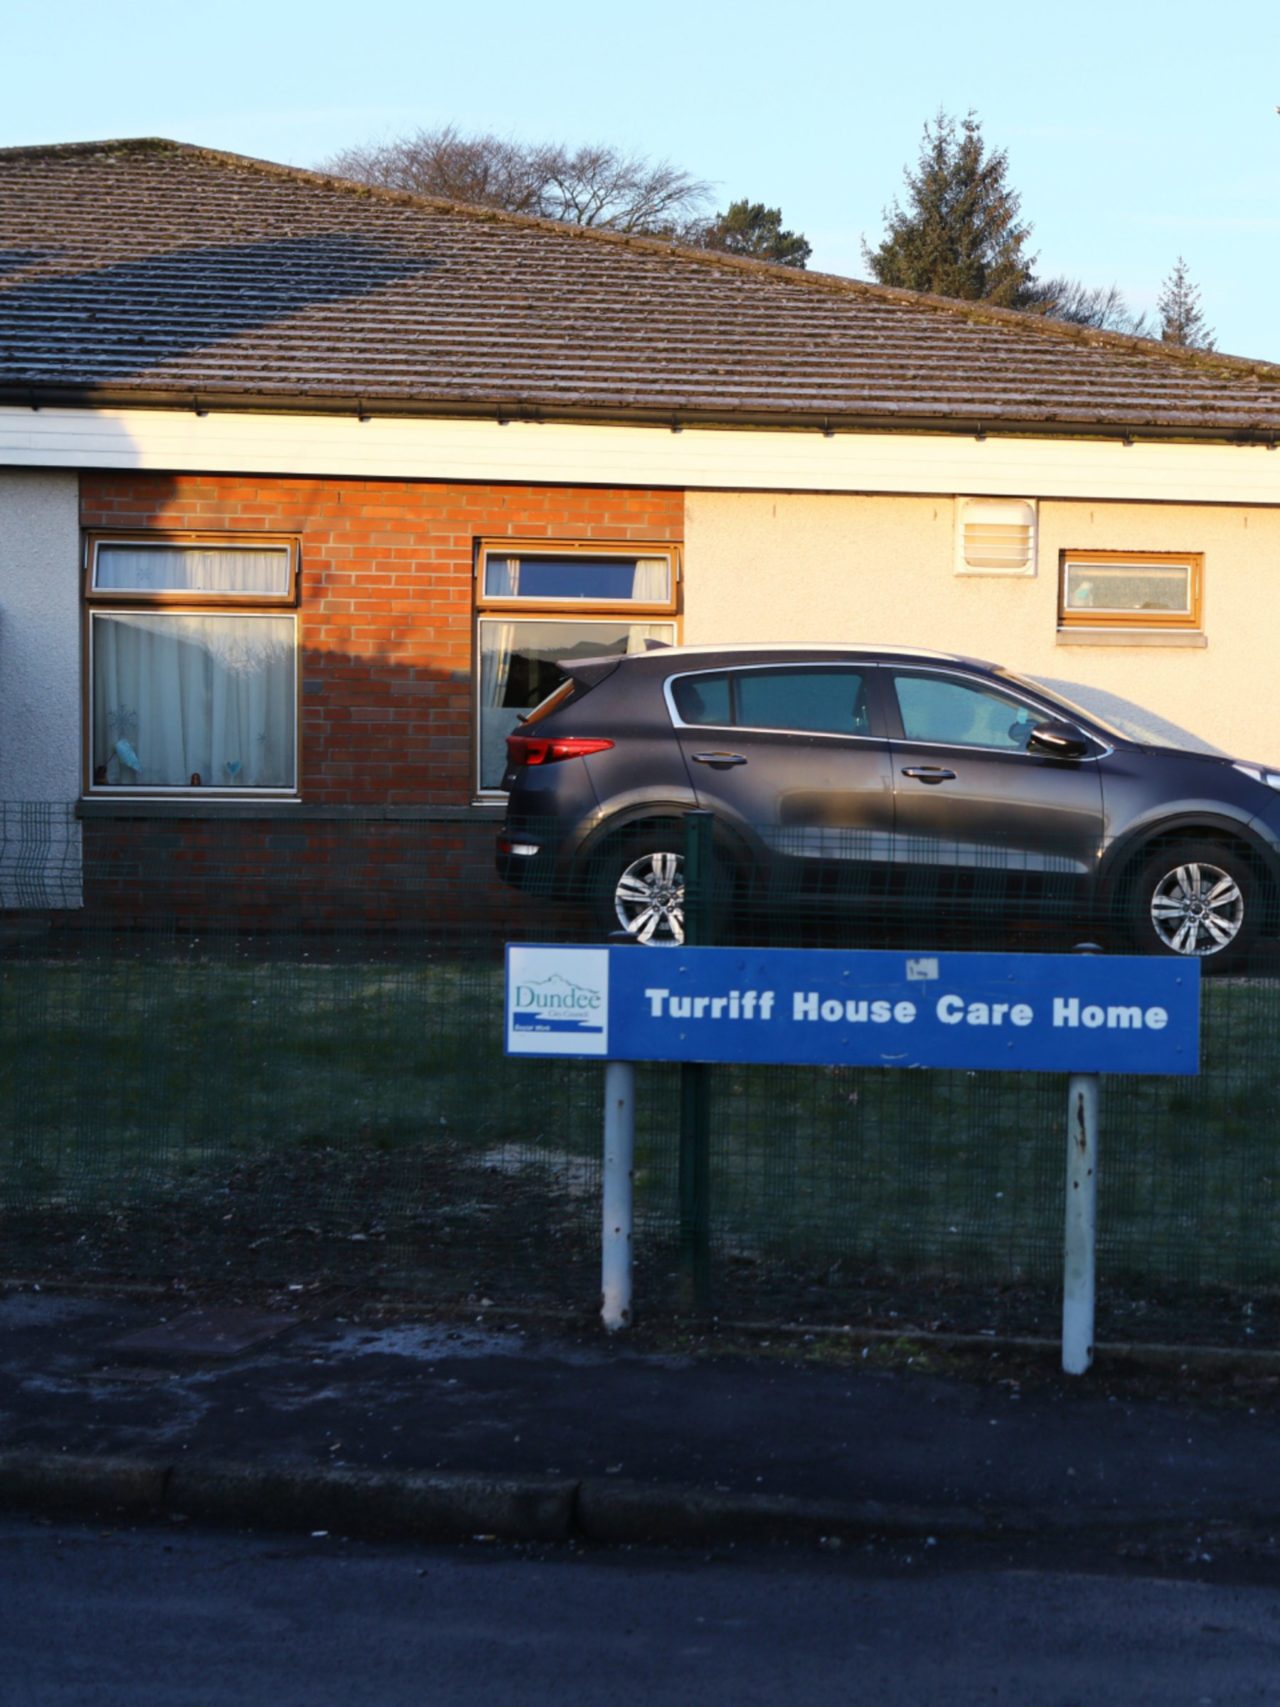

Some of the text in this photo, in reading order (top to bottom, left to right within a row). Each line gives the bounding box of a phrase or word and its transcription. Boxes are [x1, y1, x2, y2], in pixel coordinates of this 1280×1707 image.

[515, 985, 601, 1009] Dundee
[644, 988, 1169, 1029] Turriff House Care Home
